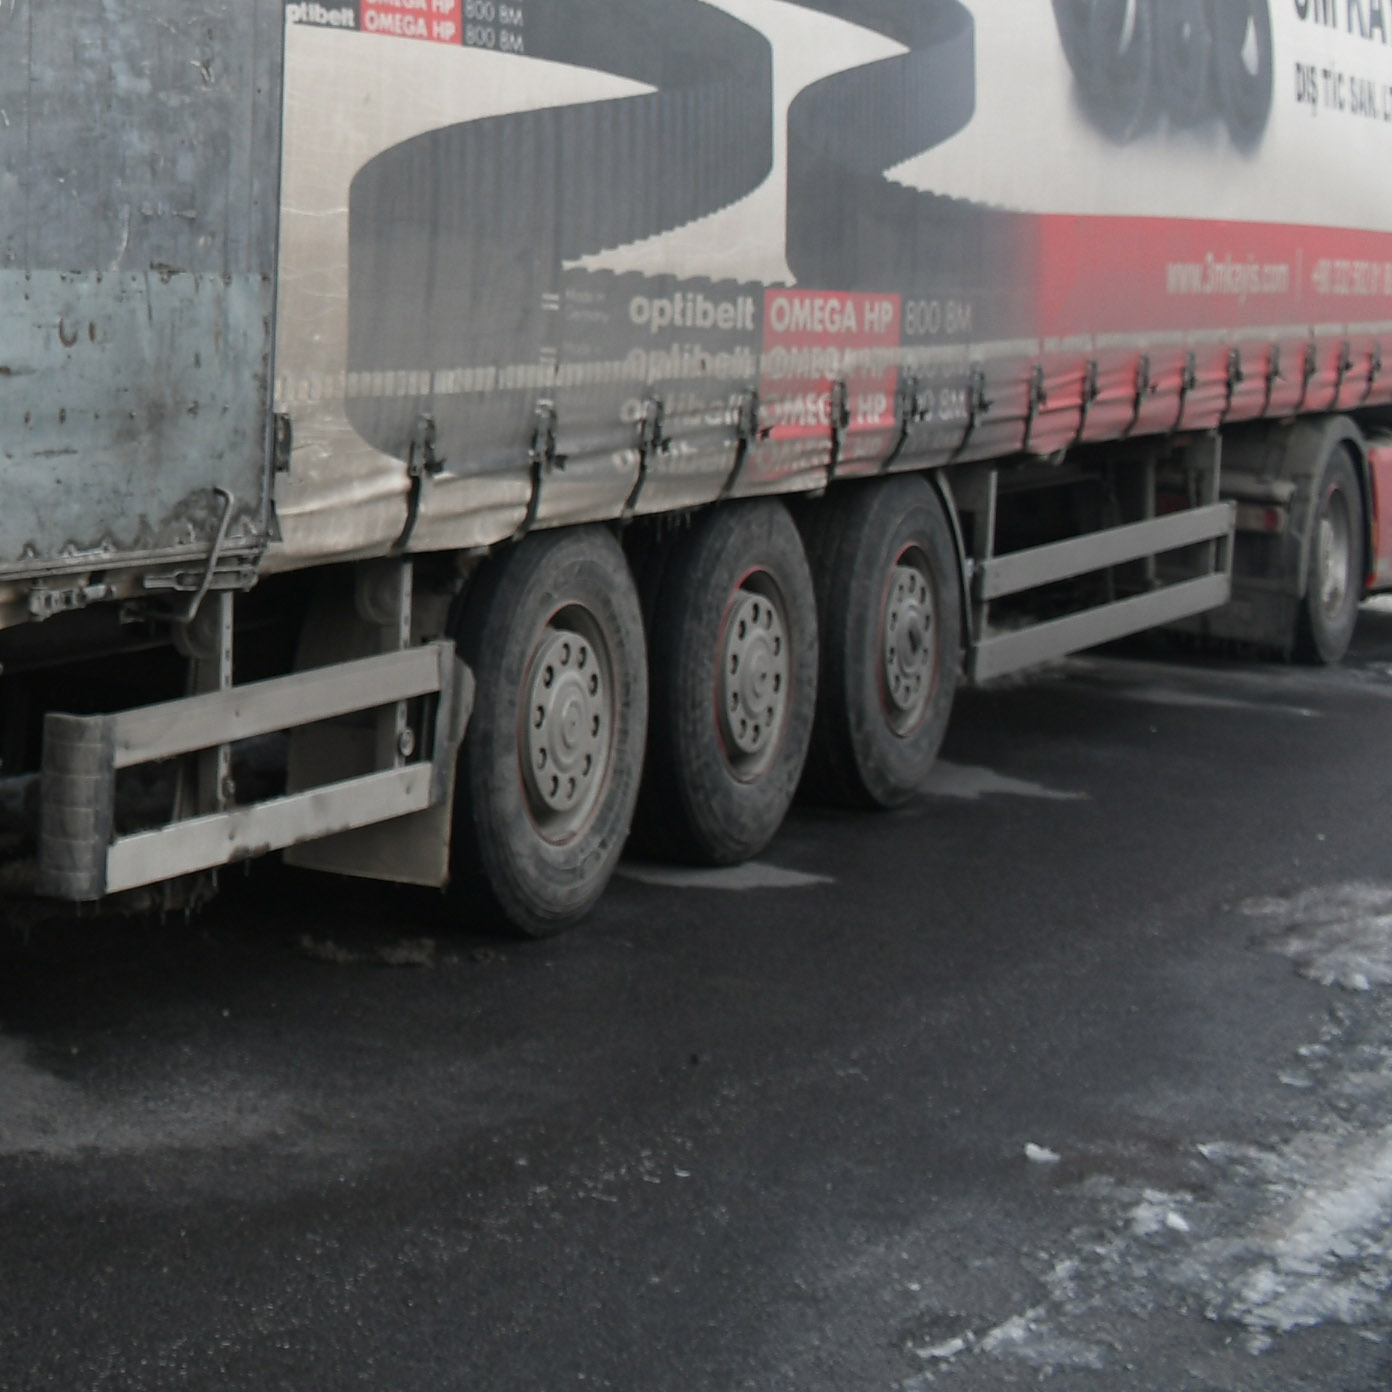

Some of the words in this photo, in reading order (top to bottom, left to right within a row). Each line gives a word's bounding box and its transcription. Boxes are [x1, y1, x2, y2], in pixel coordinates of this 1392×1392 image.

[365, 10, 428, 37] OMEGA
[432, 21, 456, 40] HP
[629, 292, 755, 334] optibelt
[770, 297, 857, 333] OMEGA
[865, 300, 894, 333] HP
[759, 392, 833, 426] OMEG
